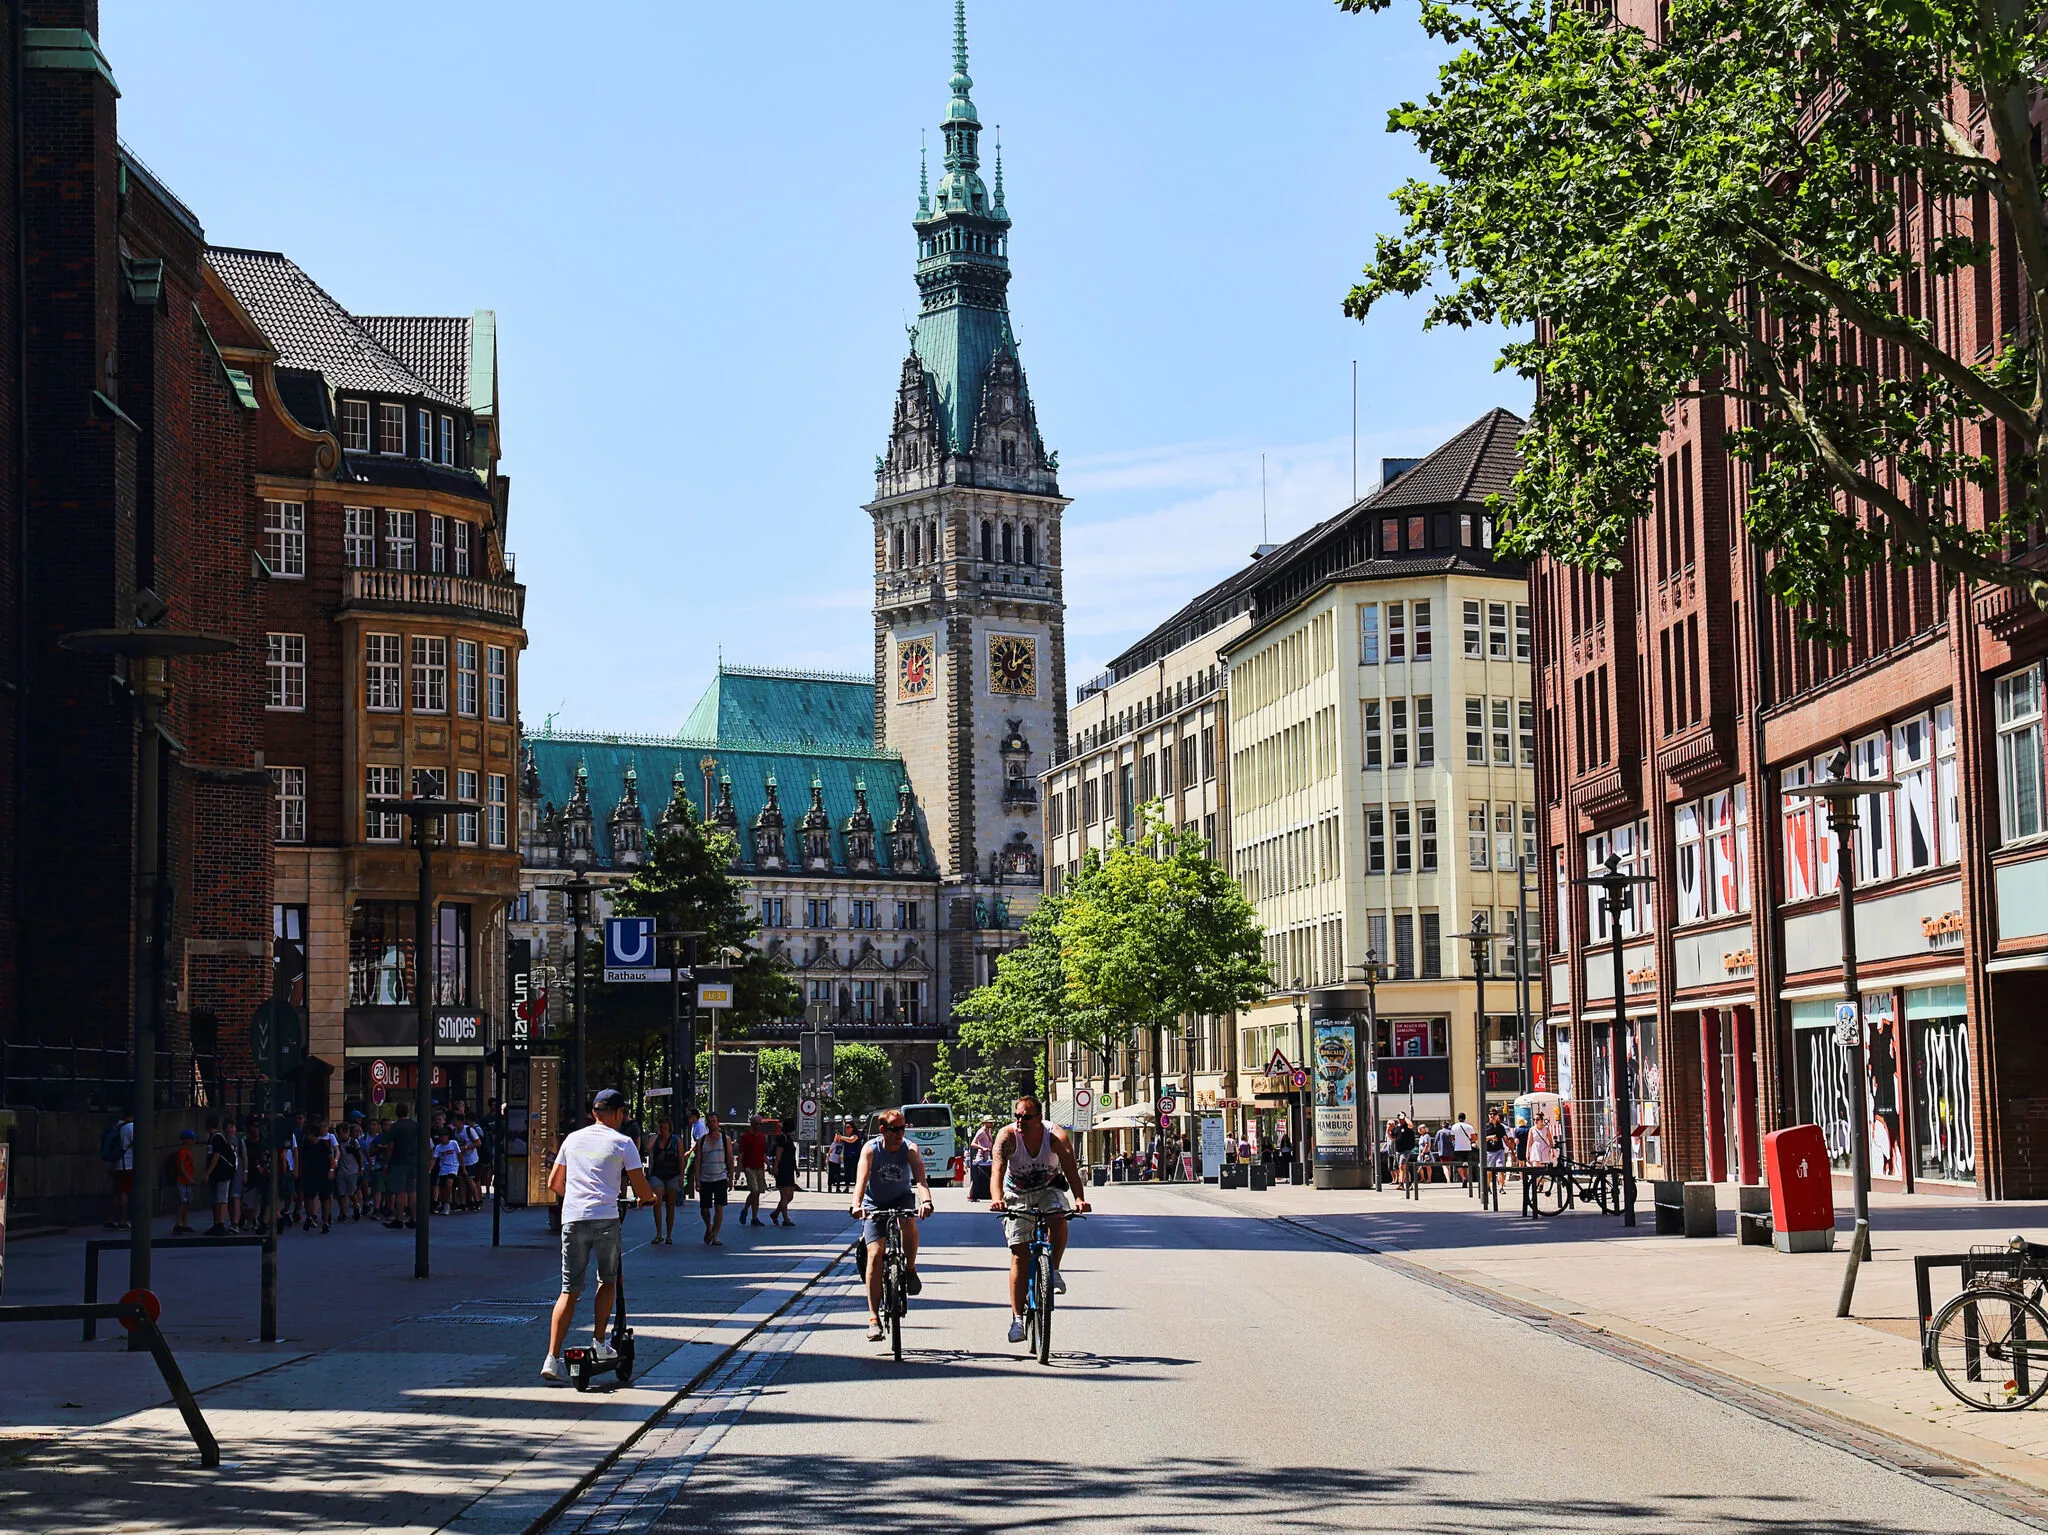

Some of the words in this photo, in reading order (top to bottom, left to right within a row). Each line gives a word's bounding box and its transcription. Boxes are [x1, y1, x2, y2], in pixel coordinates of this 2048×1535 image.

[613, 921, 647, 962] U
[608, 971, 646, 980] Rathaus
[438, 1016, 476, 1043] snipes
[375, 1065, 384, 1077] 25
[1162, 1101, 1172, 1110] 25
[1219, 1100, 1238, 1108] ara
[1317, 1121, 1353, 1131] HAMBURG
